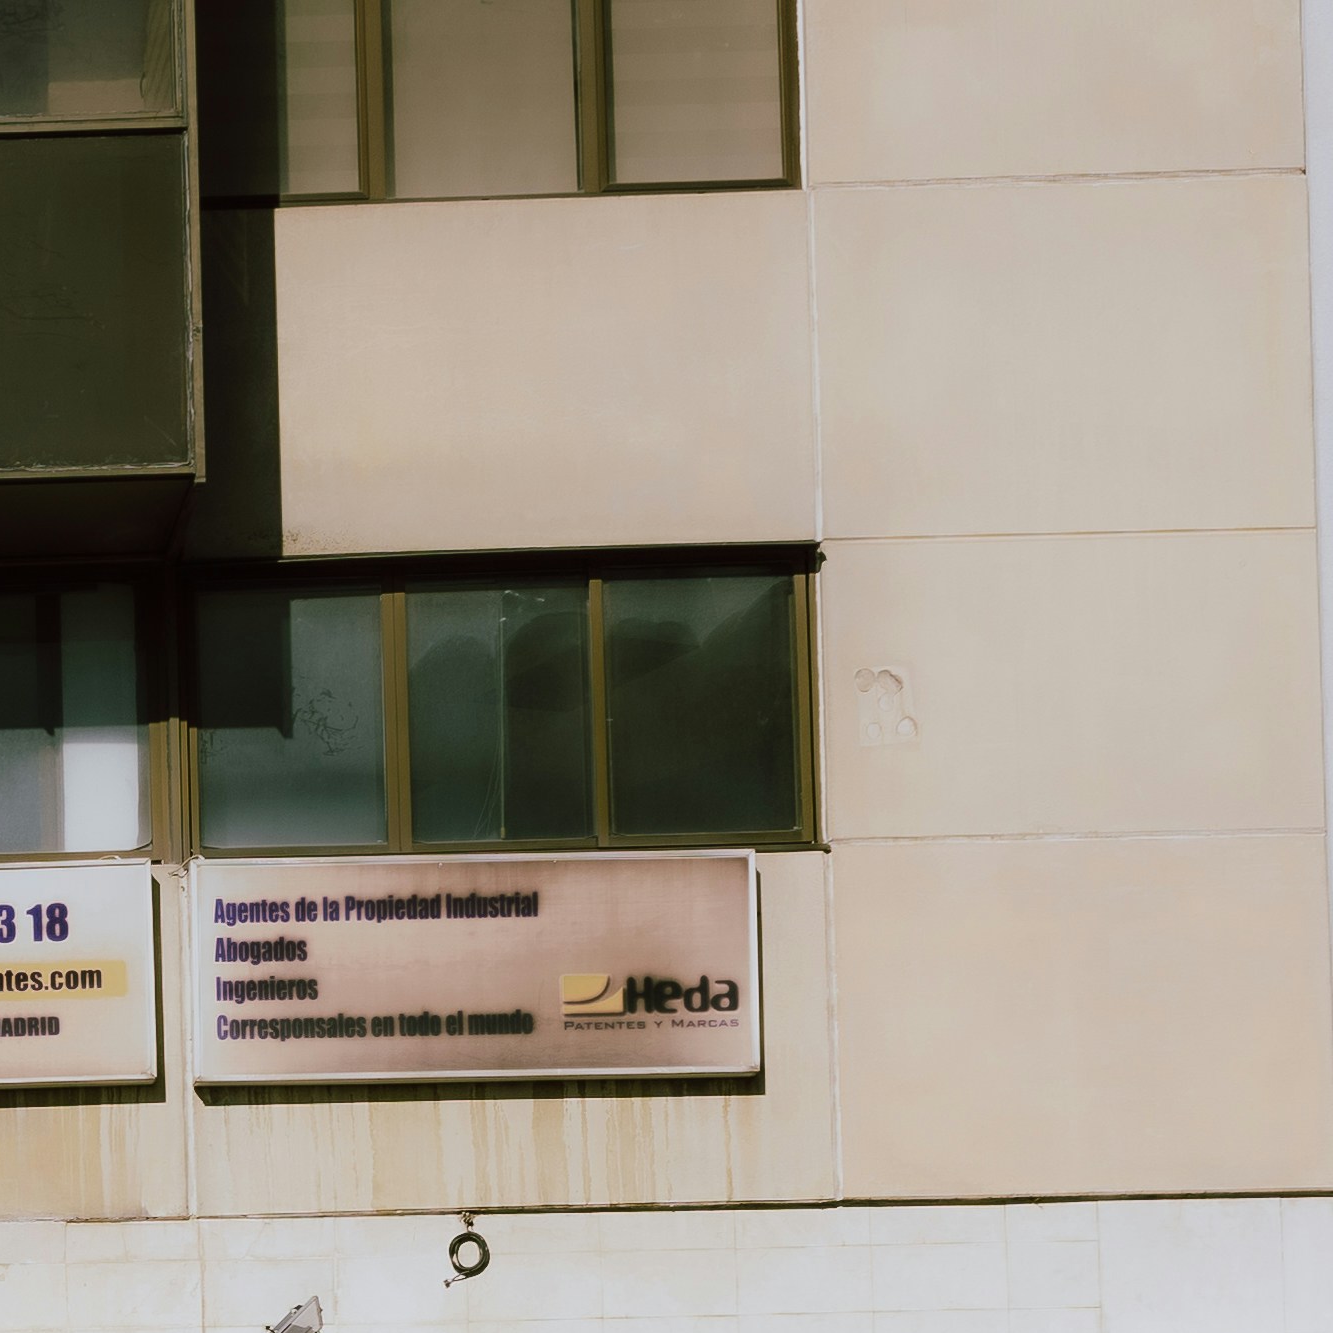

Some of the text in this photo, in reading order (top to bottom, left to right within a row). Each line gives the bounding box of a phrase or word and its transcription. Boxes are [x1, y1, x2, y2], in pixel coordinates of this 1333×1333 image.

[26, 902, 69, 942] 18
[214, 892, 539, 926] Agentes de la Propiedad Industrial
[214, 937, 308, 965] Abogados
[215, 976, 319, 1004] Ingenieros
[626, 975, 739, 1014] Heda
[217, 1009, 535, 1041] Corresponsales en todo el mundo
[564, 1018, 740, 1031] PATENTES Y MARCAS
